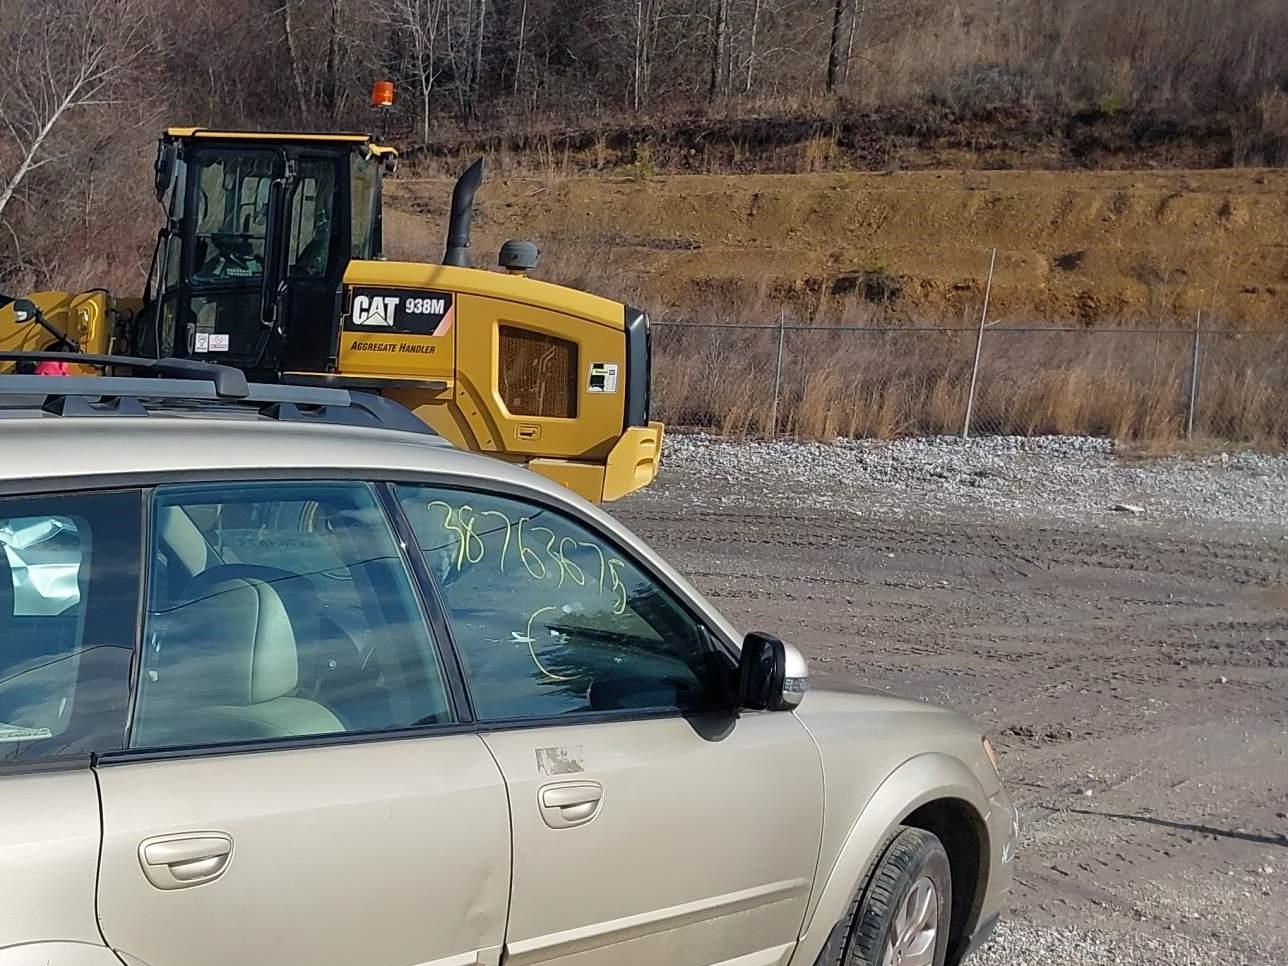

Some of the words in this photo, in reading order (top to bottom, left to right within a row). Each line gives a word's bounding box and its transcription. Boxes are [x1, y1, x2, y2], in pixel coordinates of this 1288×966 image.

[352, 295, 400, 327] CAT
[405, 298, 445, 315] 938M
[350, 340, 398, 353] AGGREGATE
[398, 343, 436, 354] HANDLER
[427, 500, 627, 615] 38763675
